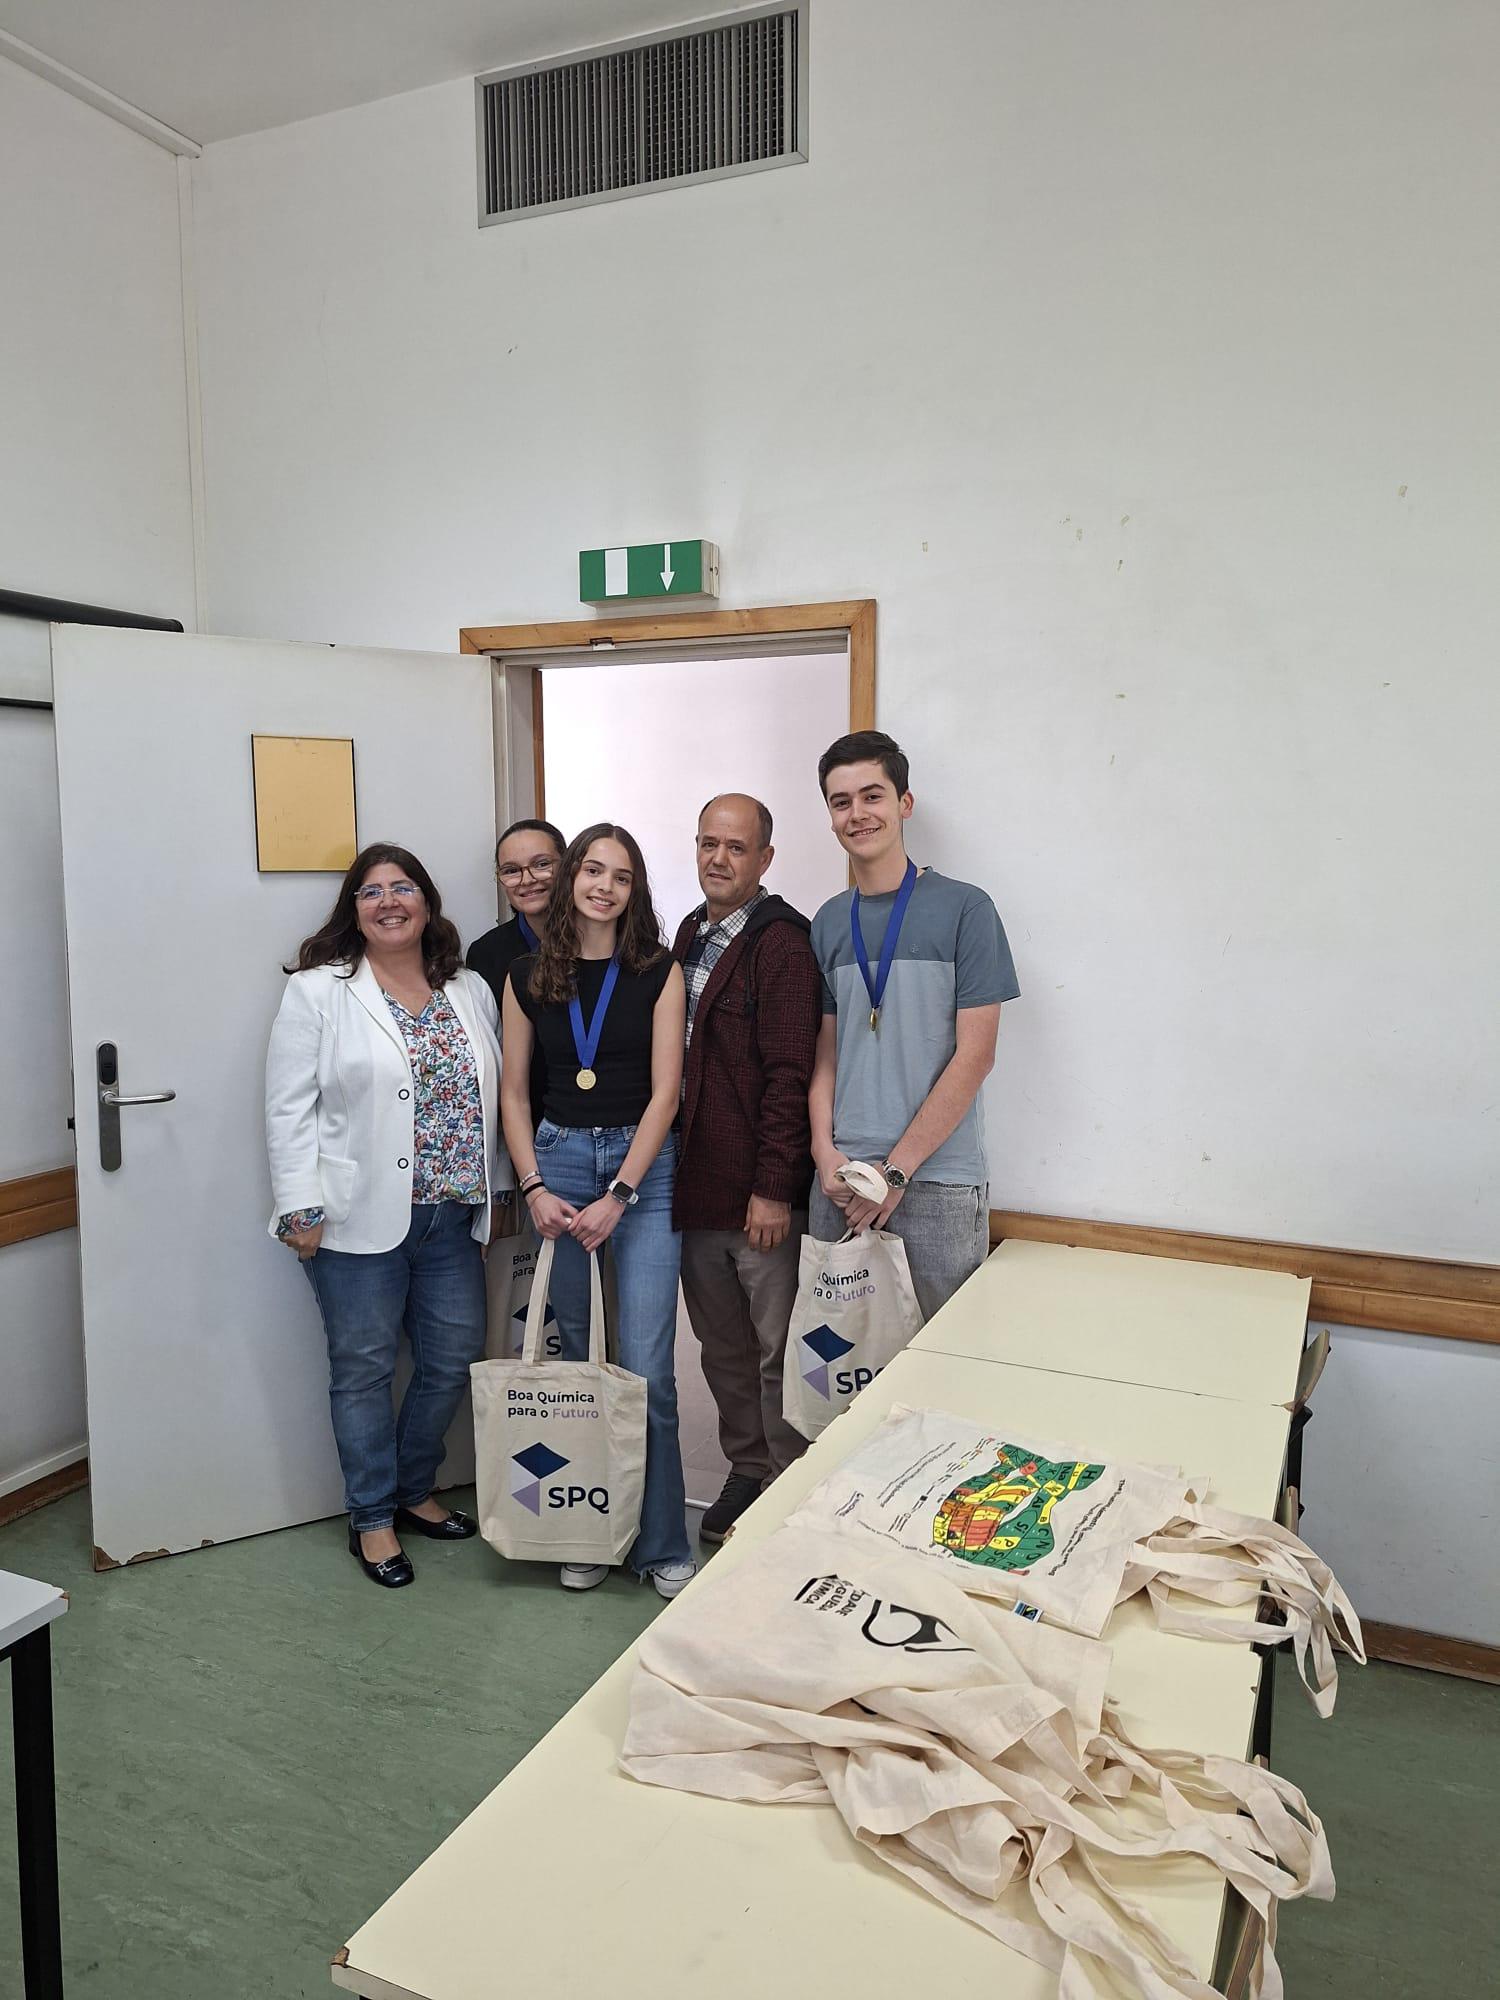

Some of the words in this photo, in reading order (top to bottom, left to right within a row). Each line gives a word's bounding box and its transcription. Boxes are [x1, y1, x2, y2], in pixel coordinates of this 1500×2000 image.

[512, 1252, 531, 1265] Boa
[822, 1267, 870, 1286] Química
[825, 1291, 832, 1300] o
[834, 1283, 876, 1301] Futuro
[835, 1366, 885, 1395] SP
[507, 1389, 533, 1401] Boa
[537, 1390, 595, 1404] Química
[507, 1406, 538, 1418] para
[540, 1409, 549, 1419] o
[552, 1407, 599, 1419] Futuro
[547, 1485, 610, 1515] SPQ
[1004, 1538, 1015, 1548] P
